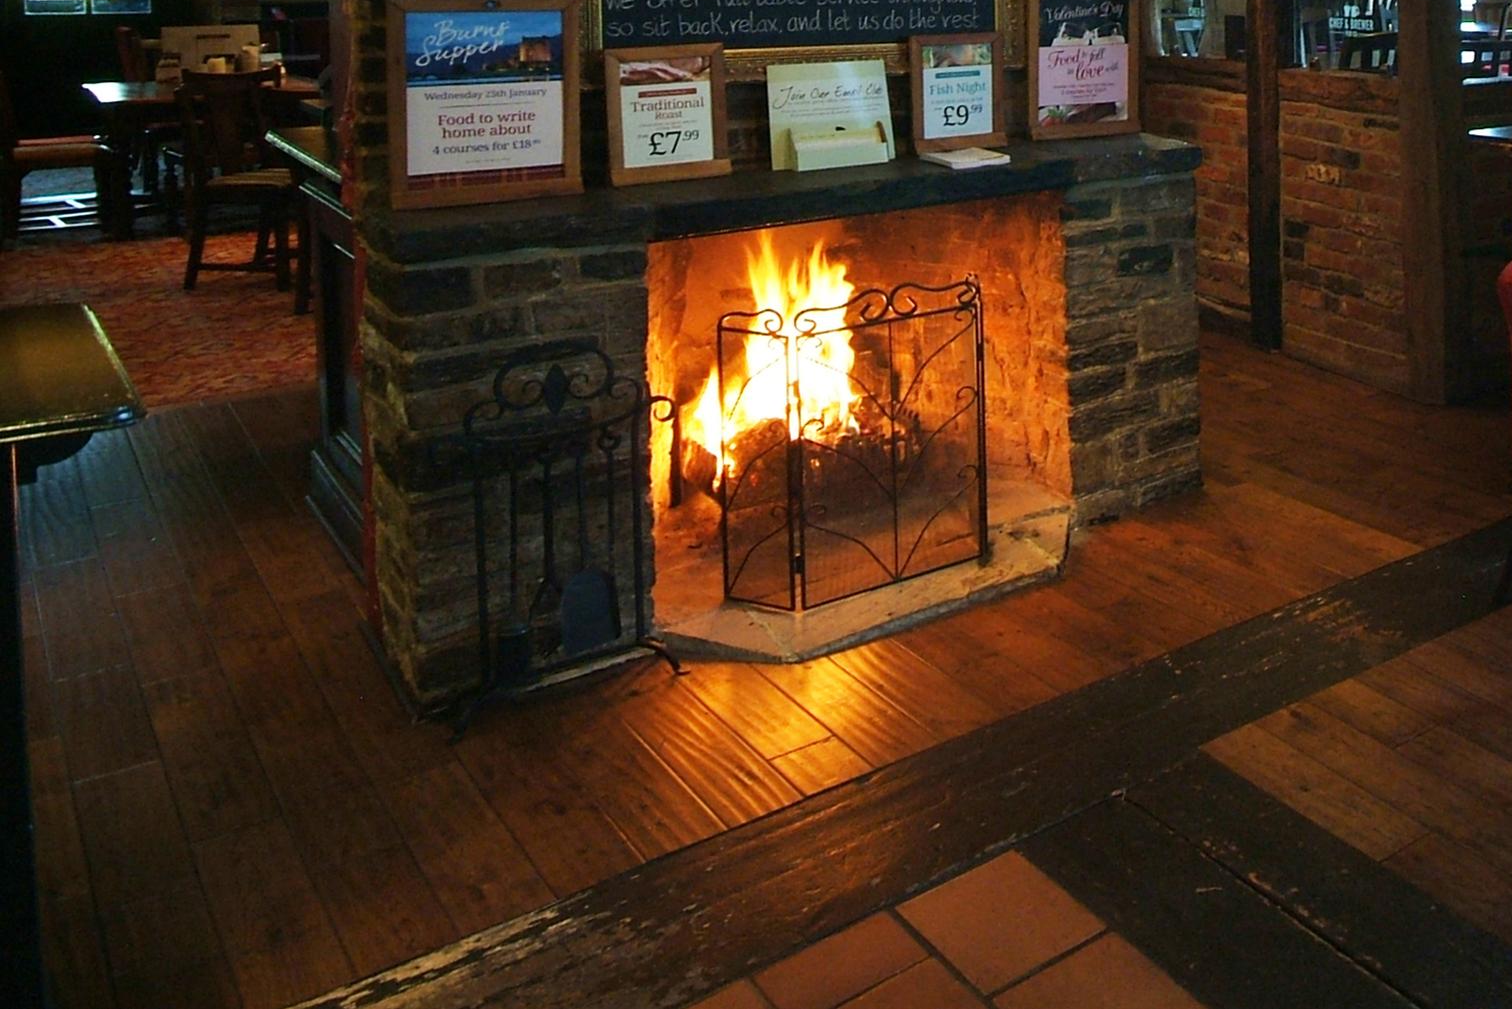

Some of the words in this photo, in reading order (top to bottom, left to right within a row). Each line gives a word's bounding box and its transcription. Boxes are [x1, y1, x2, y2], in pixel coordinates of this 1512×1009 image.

[1099, 1, 1125, 18] Day
[606, 21, 634, 37] so
[643, 13, 672, 37] sit
[787, 9, 822, 32] and
[828, 9, 851, 32] let
[858, 15, 880, 31] us
[882, 9, 904, 31] do
[908, 7, 937, 30] the
[941, 6, 981, 30] rest
[1328, 17, 1343, 30] CHEF
[434, 19, 511, 47] Burns
[415, 35, 506, 67] Supper
[1047, 48, 1081, 70] Food
[1075, 61, 1105, 81] love
[424, 90, 483, 101] Wednesday
[508, 87, 548, 100] January
[929, 83, 954, 96] Fish
[956, 81, 987, 96] Night
[630, 96, 705, 113] Traditional
[437, 112, 475, 127] Food
[479, 113, 494, 124] to
[497, 110, 536, 124] write
[655, 111, 683, 121] Roast
[441, 125, 486, 140] home
[489, 123, 532, 137] about
[432, 146, 440, 155] 4
[443, 143, 490, 155] courses
[492, 140, 511, 152] for
[648, 129, 700, 156] £7.99
